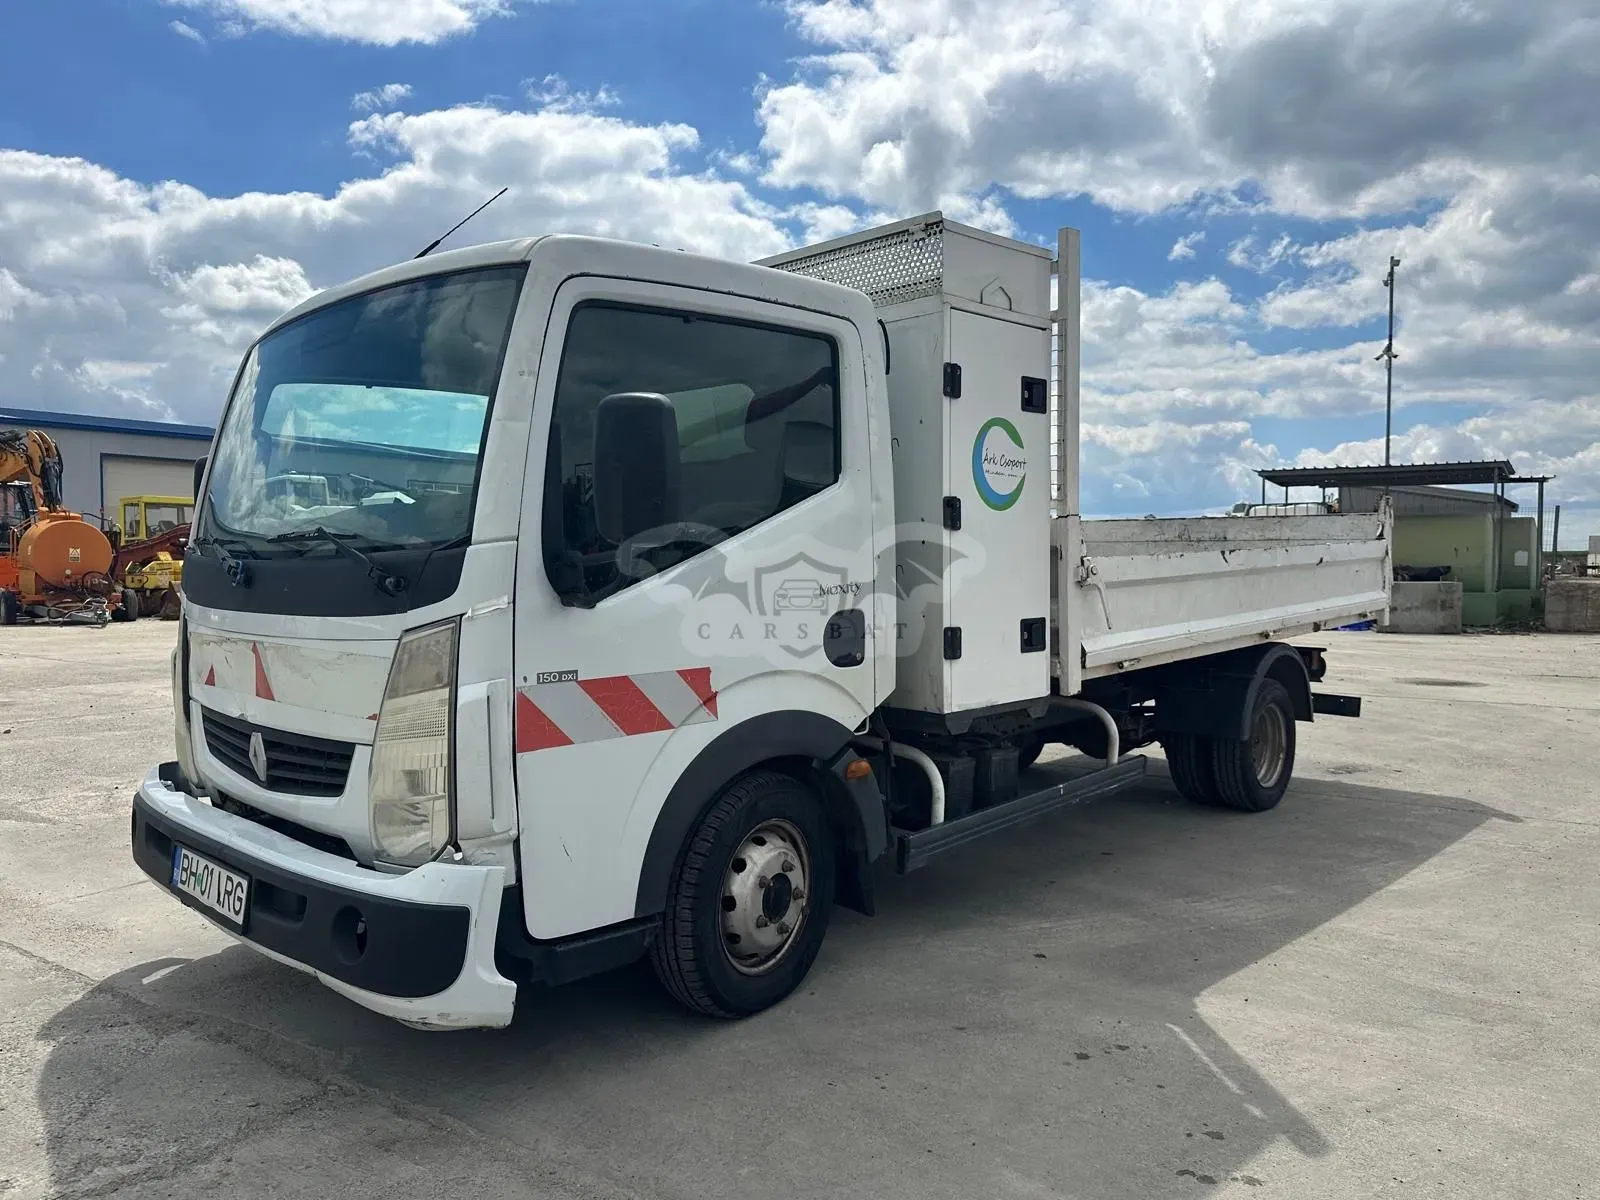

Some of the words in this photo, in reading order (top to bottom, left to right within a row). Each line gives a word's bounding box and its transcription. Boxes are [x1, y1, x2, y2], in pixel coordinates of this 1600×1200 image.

[819, 581, 862, 597] Maxity
[538, 672, 559, 683] 150
[179, 853, 200, 891] BH
[199, 863, 215, 901] 01
[216, 870, 244, 916] LRG
